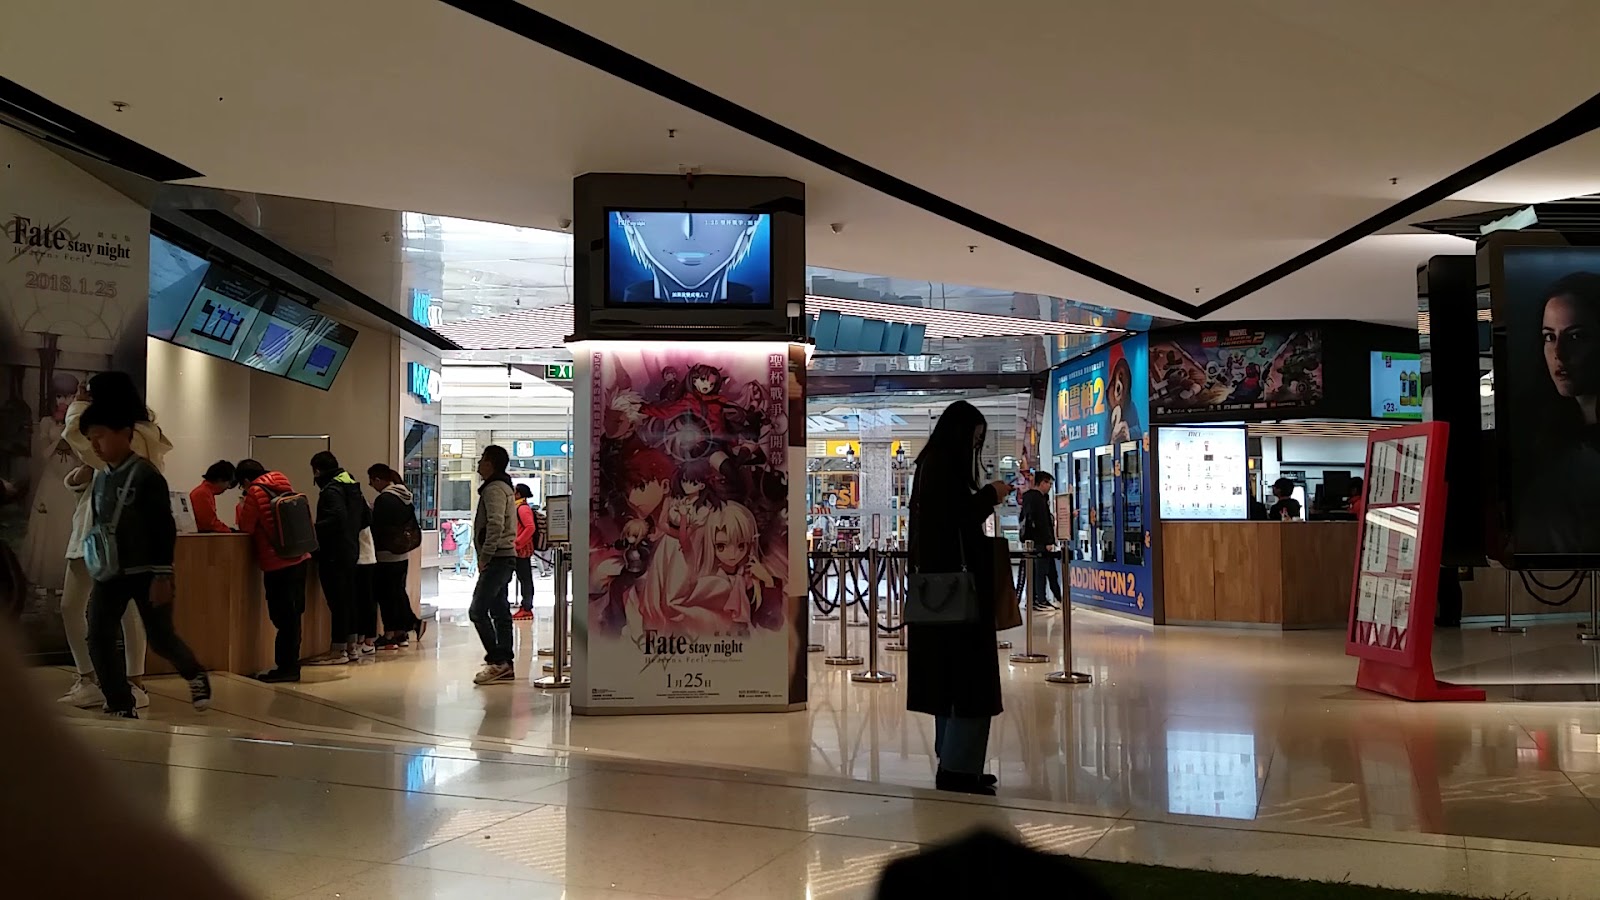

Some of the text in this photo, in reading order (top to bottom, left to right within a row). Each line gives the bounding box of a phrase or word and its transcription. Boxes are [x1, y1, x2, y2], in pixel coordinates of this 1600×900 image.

[13, 215, 131, 261] Fate stay night
[25, 270, 118, 299] 2018.1.25
[547, 365, 574, 378] EXI
[1069, 566, 1136, 598] ADDiNGTON 2
[643, 629, 743, 657] Fate stay night
[666, 673, 712, 689] 1月25日
